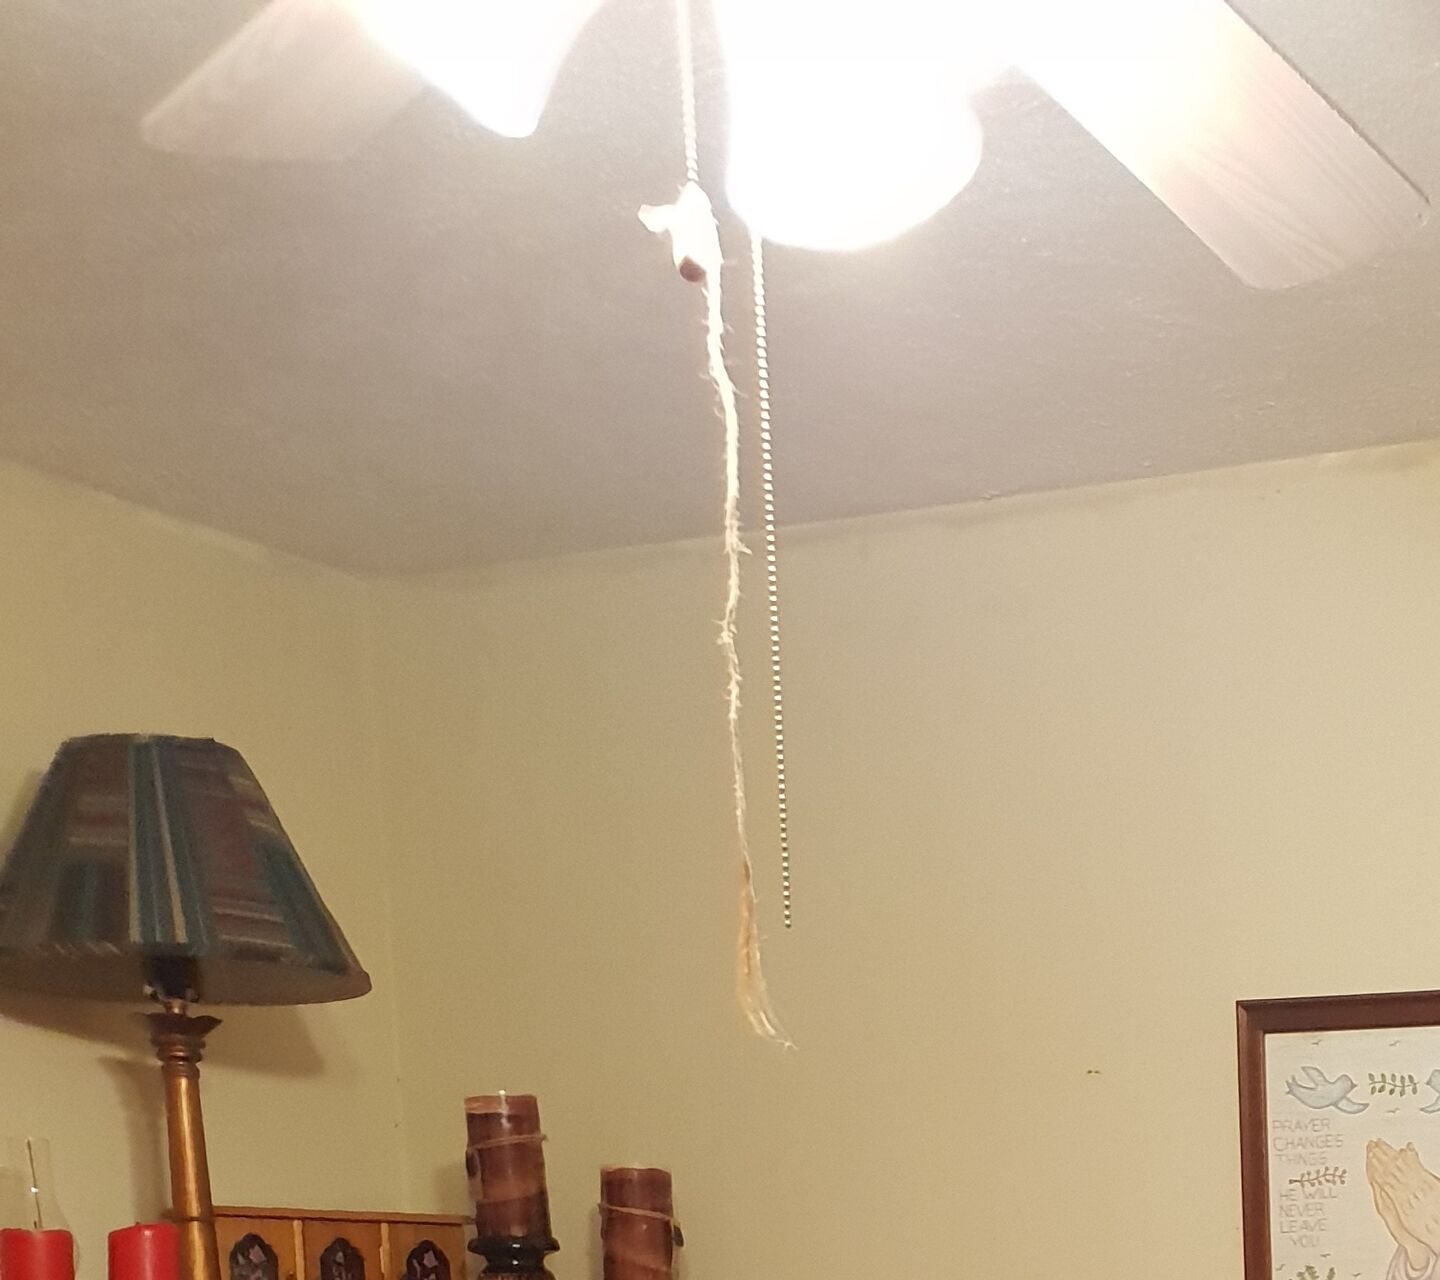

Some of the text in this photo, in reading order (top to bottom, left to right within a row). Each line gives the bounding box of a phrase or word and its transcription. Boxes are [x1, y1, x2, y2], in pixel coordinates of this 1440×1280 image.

[1272, 1118, 1330, 1132] PRAYER
[1272, 1134, 1344, 1151] CHANGES
[1279, 1186, 1338, 1201] HE WILL
[1279, 1201, 1325, 1217] NEVER
[1279, 1217, 1329, 1234] LEAVE
[1288, 1233, 1321, 1249] YOU
